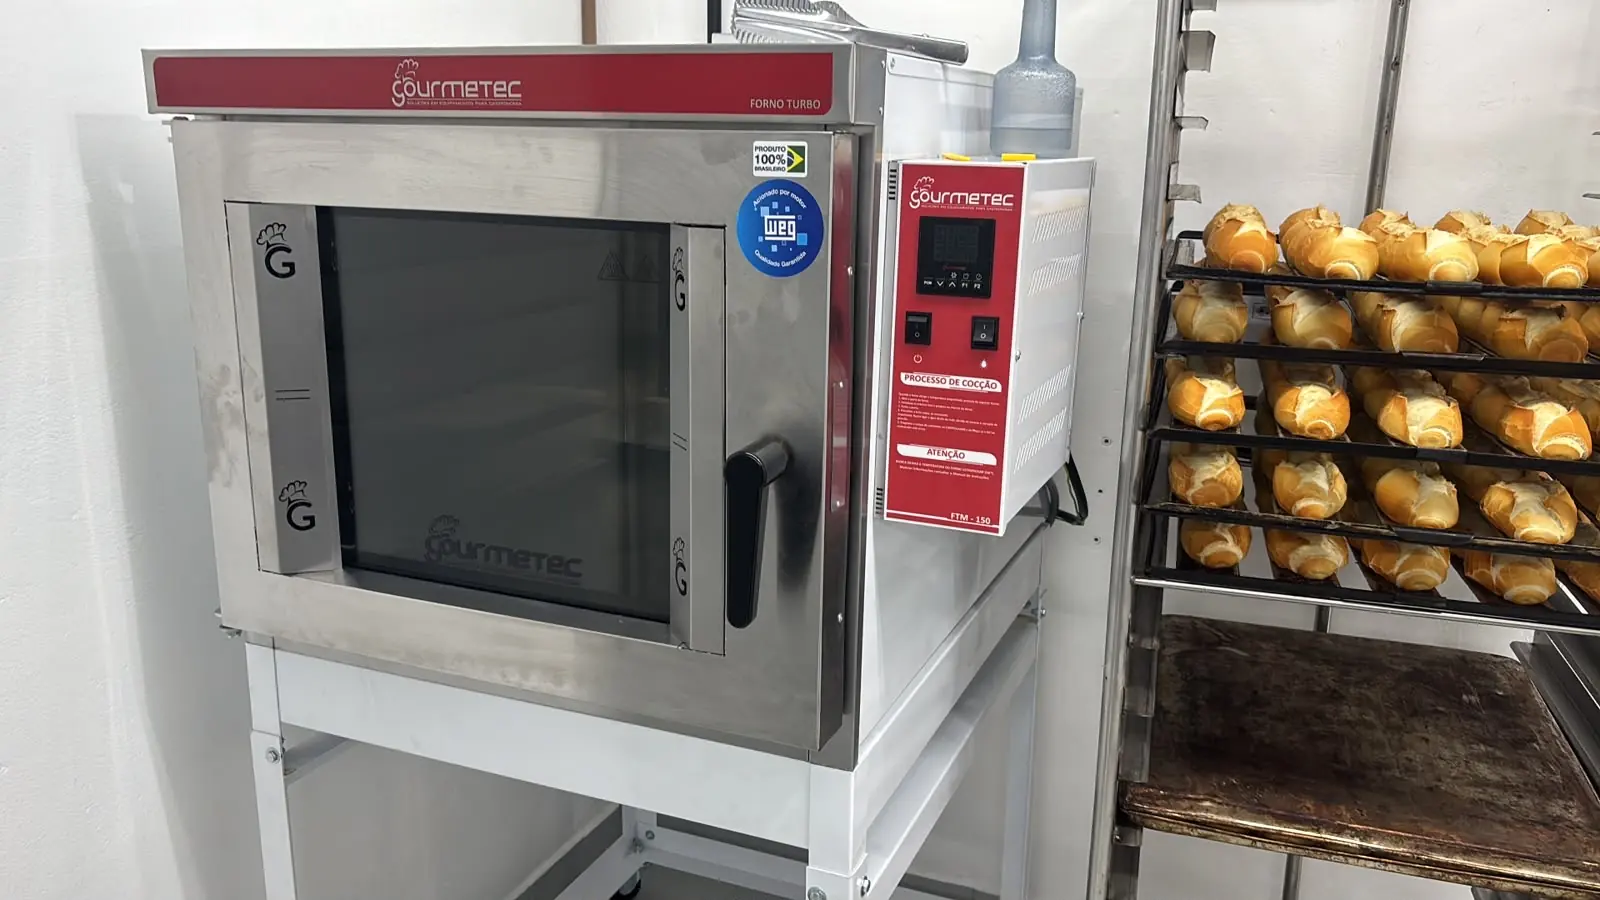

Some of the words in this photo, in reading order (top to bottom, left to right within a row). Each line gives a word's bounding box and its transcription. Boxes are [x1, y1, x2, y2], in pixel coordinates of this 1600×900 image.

[750, 99, 785, 109] FORNO
[787, 99, 821, 109] TURBO
[755, 154, 786, 165] 100%
[753, 188, 779, 208] Acionado
[779, 189, 791, 197] por
[790, 192, 808, 210] motor
[264, 245, 296, 279] G
[754, 249, 780, 268] Qualidade
[780, 250, 807, 268] Garantida
[674, 273, 686, 312] G
[904, 374, 947, 385] PROCESSO
[948, 378, 960, 387] DE
[961, 379, 998, 390] COCÇÃO
[926, 448, 966, 459] ATENÇÃO
[286, 501, 316, 531] G
[950, 512, 969, 522] FTM
[975, 516, 991, 525] 150
[675, 561, 687, 597] G
